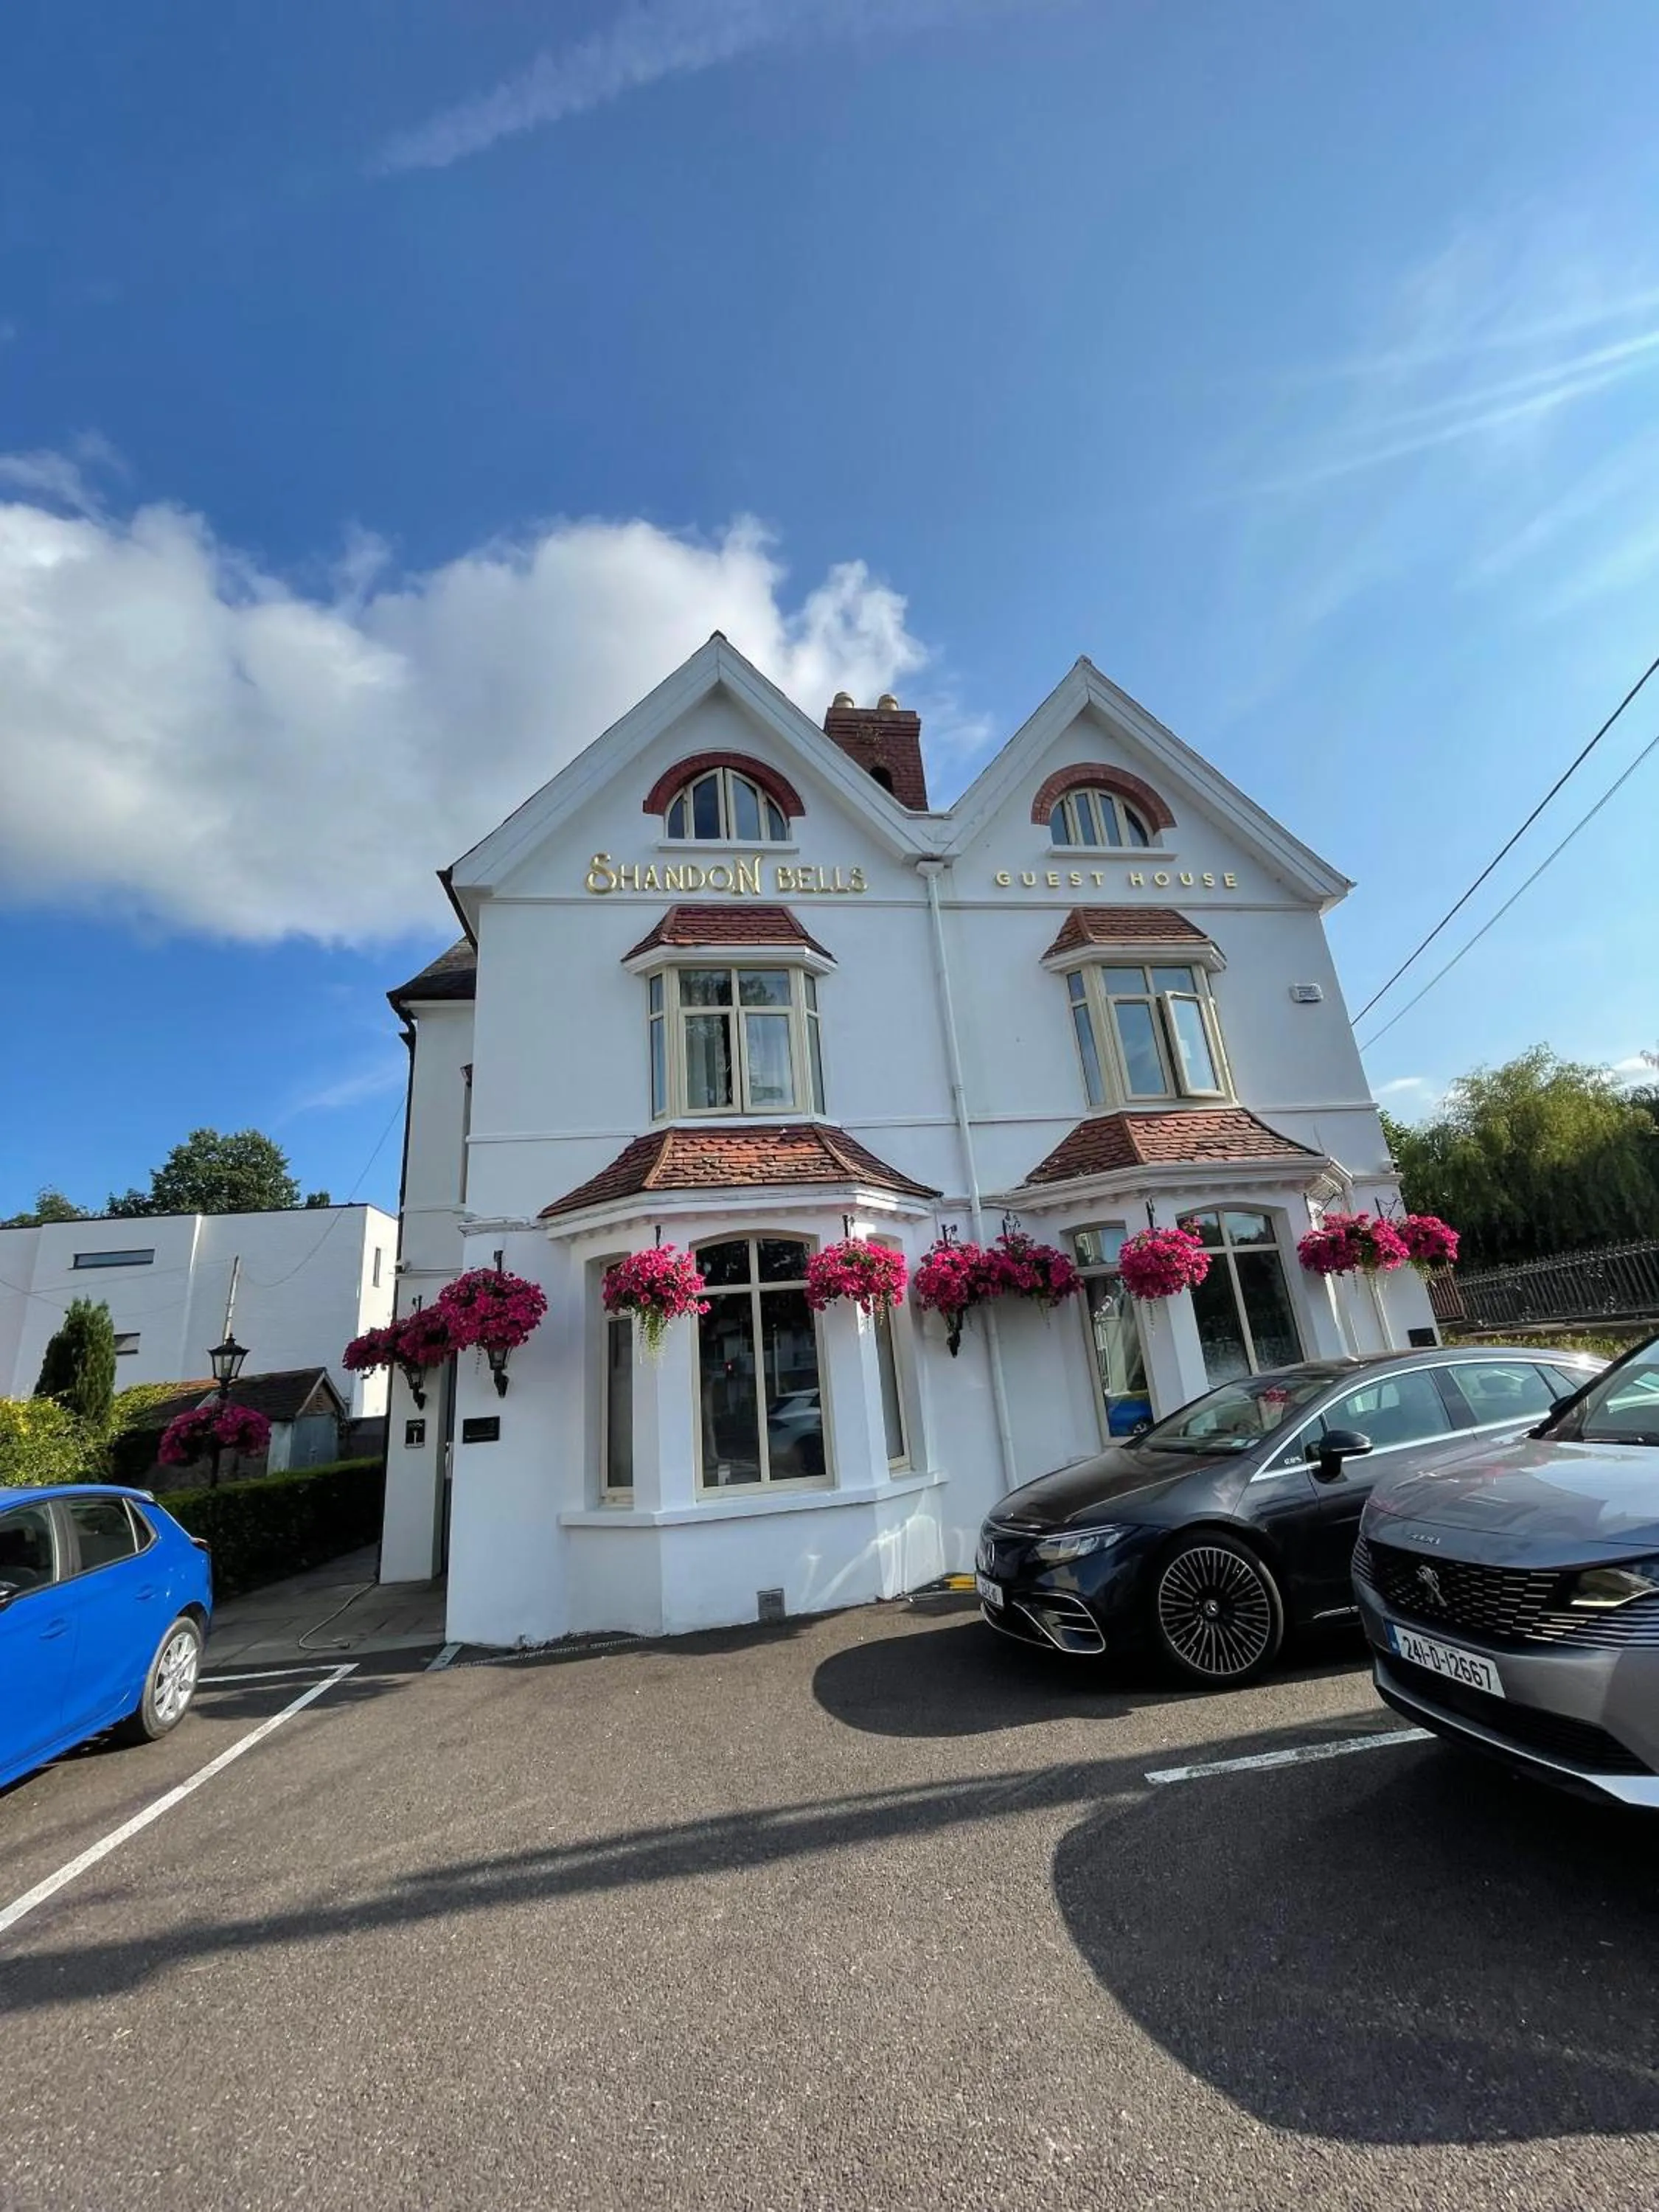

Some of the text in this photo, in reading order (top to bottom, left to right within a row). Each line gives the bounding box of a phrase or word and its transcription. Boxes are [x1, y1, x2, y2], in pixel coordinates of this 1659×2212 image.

[587, 852, 869, 895] SHANDON BELLS
[995, 870, 1238, 888] GUEST HOUSE
[1402, 1635, 1492, 1691] 241-D-12667
